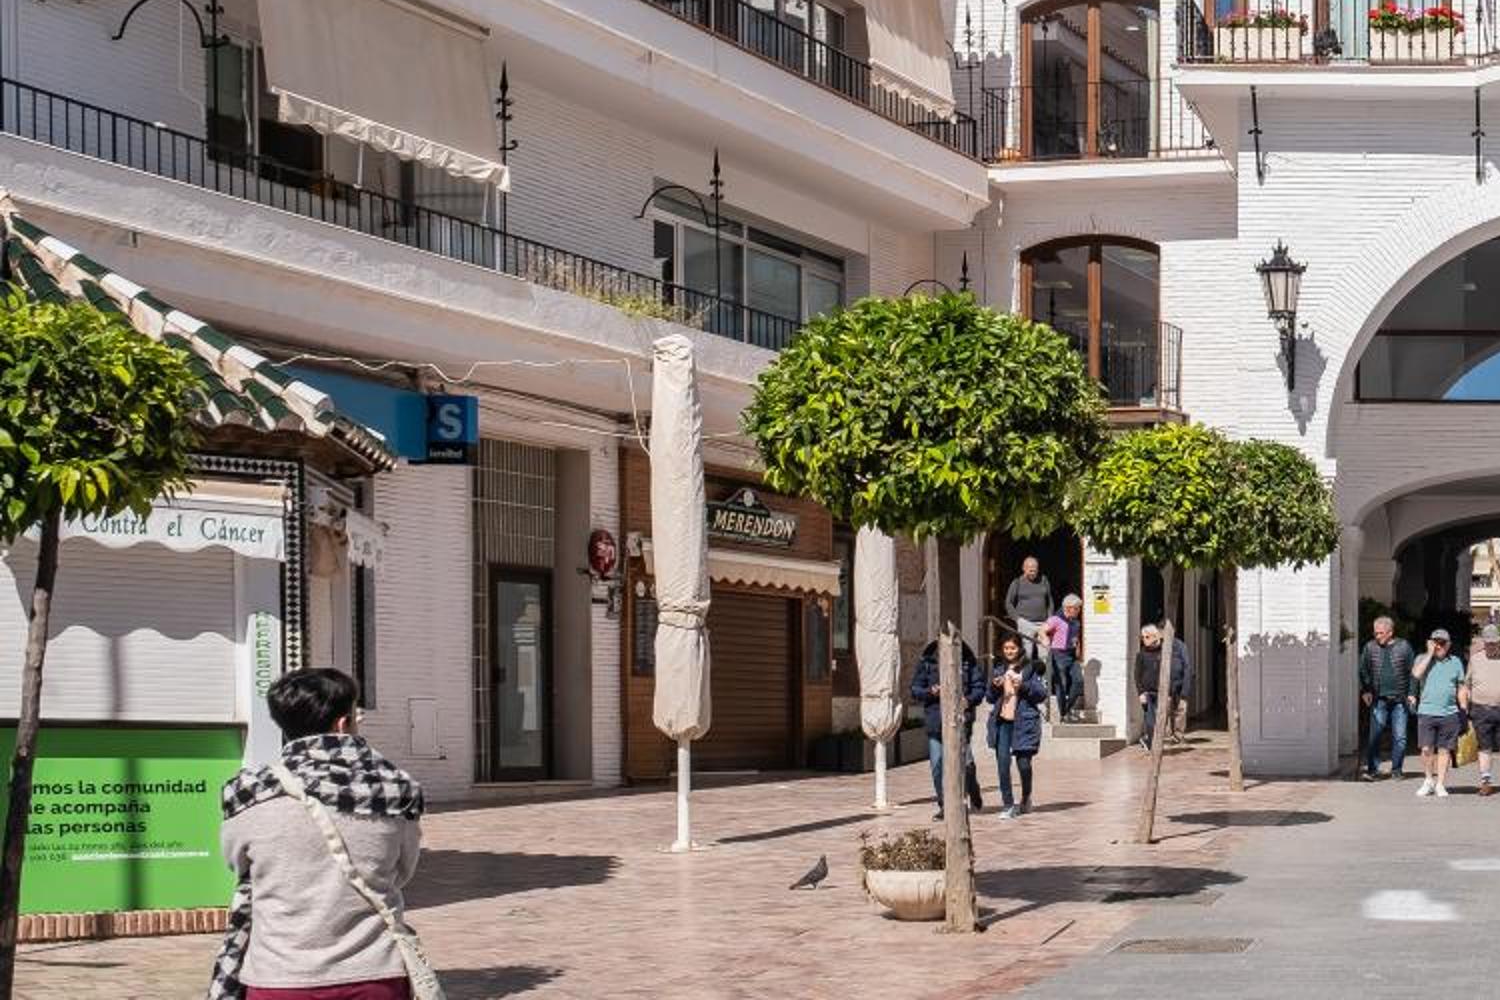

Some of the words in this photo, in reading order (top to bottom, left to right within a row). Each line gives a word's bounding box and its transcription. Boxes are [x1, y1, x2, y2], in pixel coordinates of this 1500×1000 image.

[438, 403, 462, 440] S
[167, 515, 182, 537] el
[200, 516, 265, 543] Cáncer
[713, 508, 795, 539] MERENDON
[32, 783, 73, 795] mos
[79, 780, 96, 794] la
[101, 779, 207, 794] comunidad
[51, 800, 151, 816] acompaña
[59, 820, 147, 837] personas
